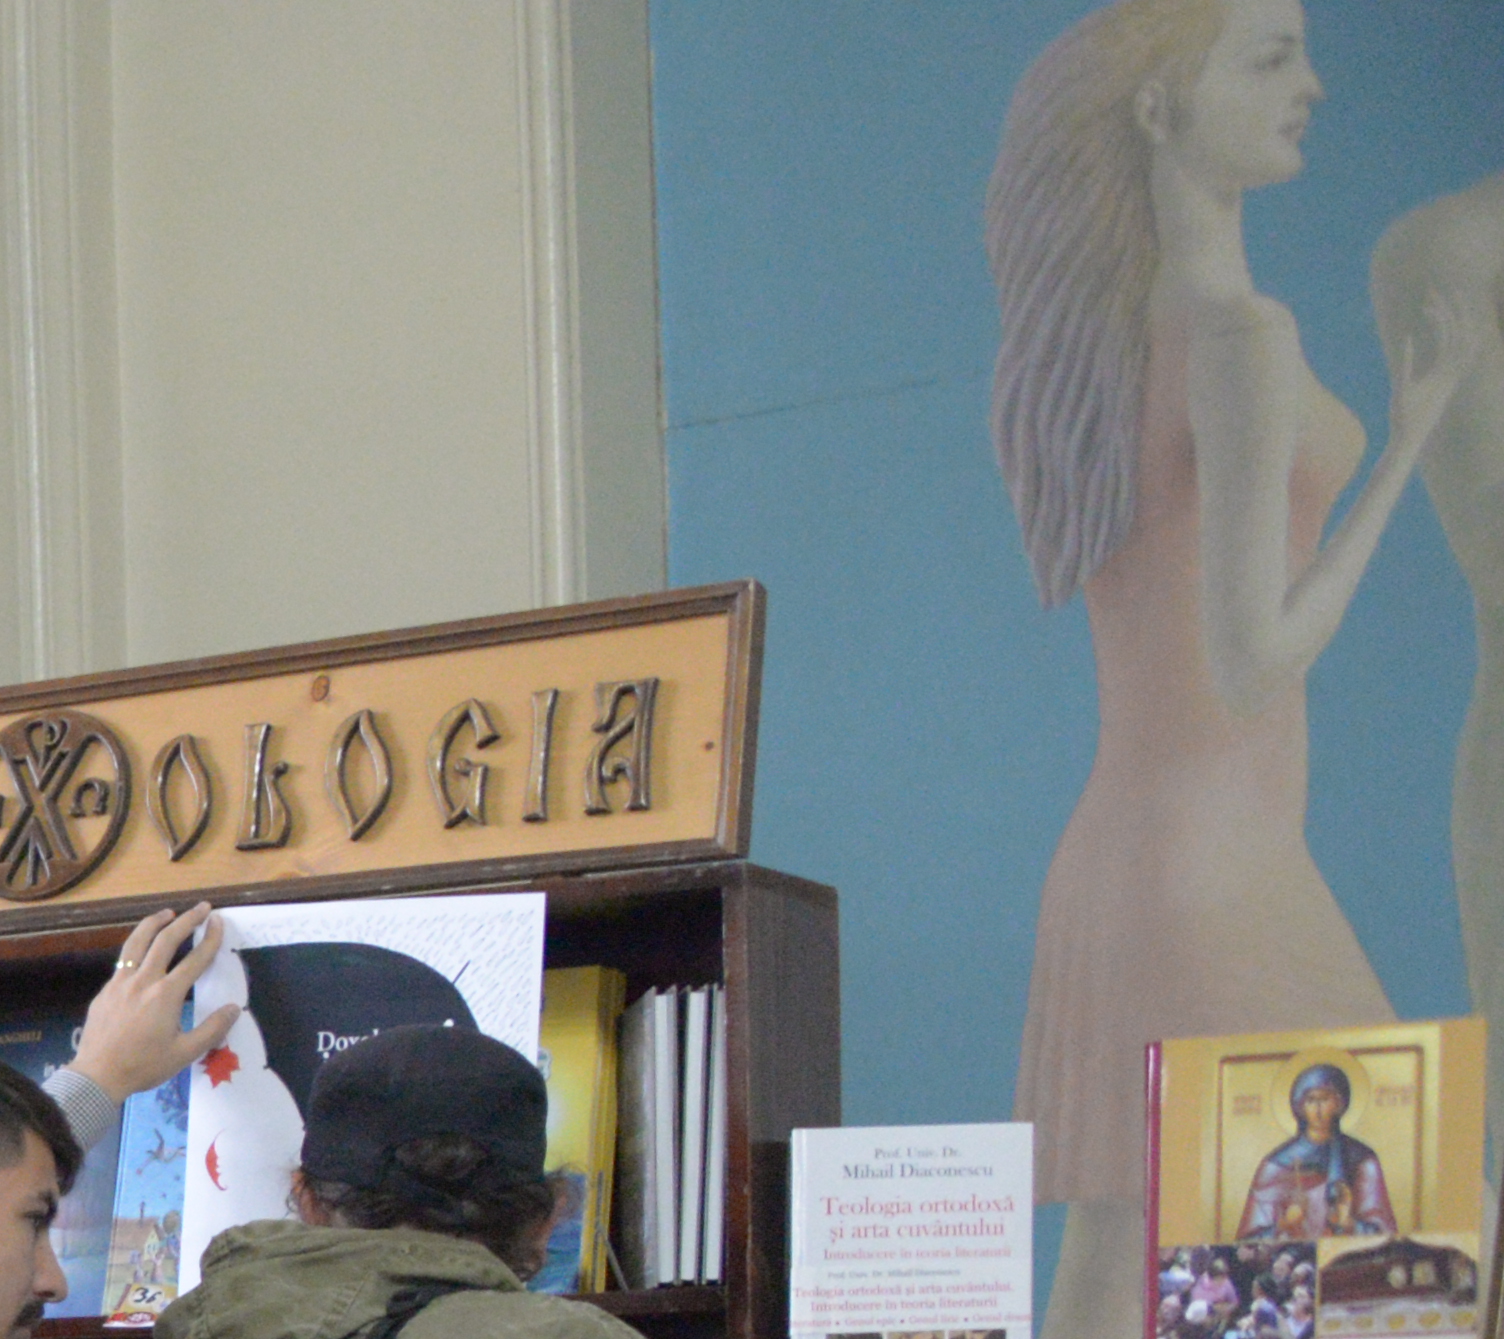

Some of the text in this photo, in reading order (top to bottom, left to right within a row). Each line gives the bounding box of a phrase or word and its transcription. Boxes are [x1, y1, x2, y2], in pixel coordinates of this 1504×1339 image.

[842, 1162, 994, 1180] Mihail Diaconescu
[820, 1193, 1015, 1219] Teologia ortodoxă
[851, 1221, 890, 1239] arta
[896, 1217, 1006, 1239] cuvântului
